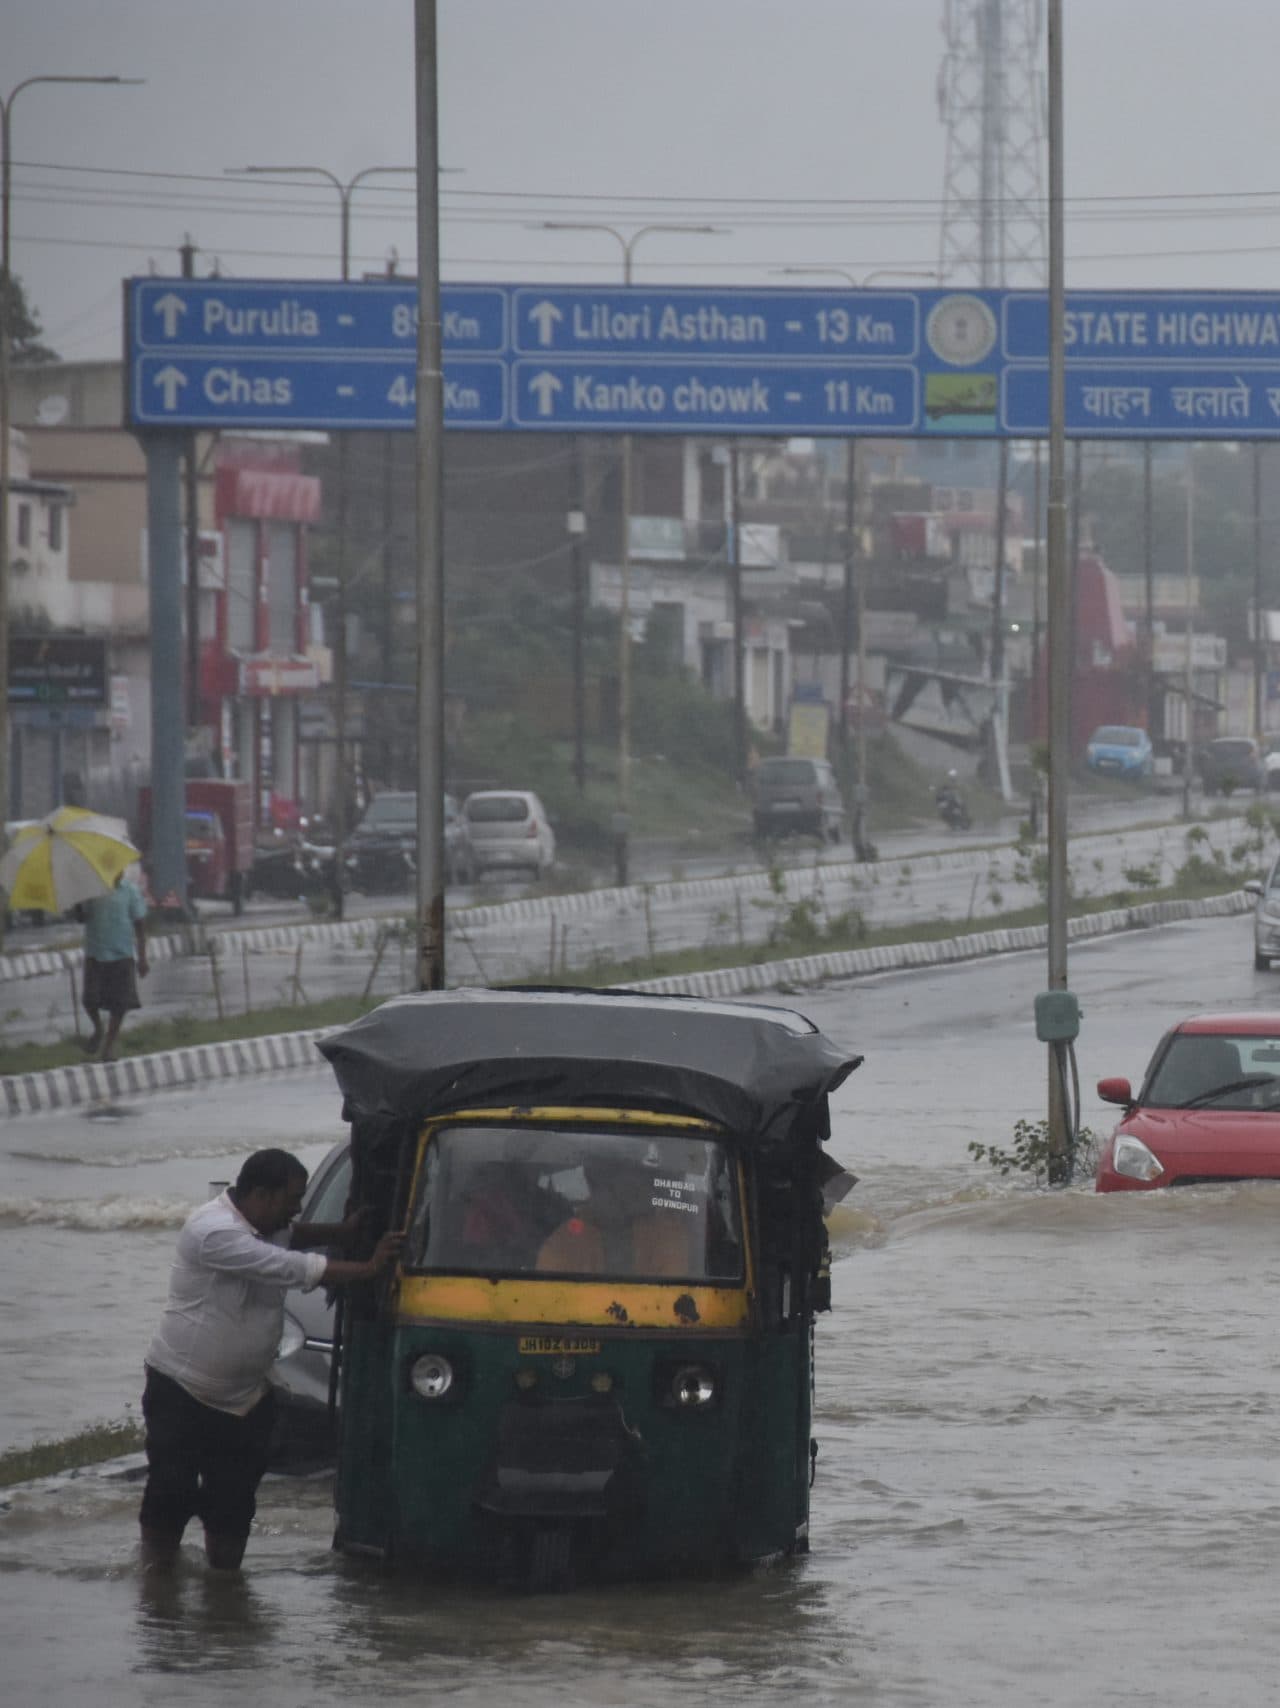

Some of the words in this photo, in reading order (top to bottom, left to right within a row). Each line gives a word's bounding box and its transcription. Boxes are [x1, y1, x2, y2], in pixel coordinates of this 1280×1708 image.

[203, 299, 319, 336] Purulia
[392, 303, 419, 338] 8
[443, 311, 480, 339] Km
[573, 304, 651, 340] Lilori
[658, 307, 766, 342] Asthan
[817, 309, 849, 343] 13
[856, 316, 894, 343] Km
[1064, 312, 1148, 345] STATE
[203, 369, 291, 405] Chas
[387, 375, 418, 407] 4
[443, 382, 480, 409] Km
[573, 376, 665, 412] Kanko
[673, 380, 769, 413] chowk
[825, 381, 848, 415] 11
[856, 388, 894, 414] Km
[1082, 386, 1151, 419] वाहन
[1170, 375, 1252, 418] चलाते
[651, 1197, 699, 1214] GOVINDPUR
[669, 1189, 682, 1199] TO
